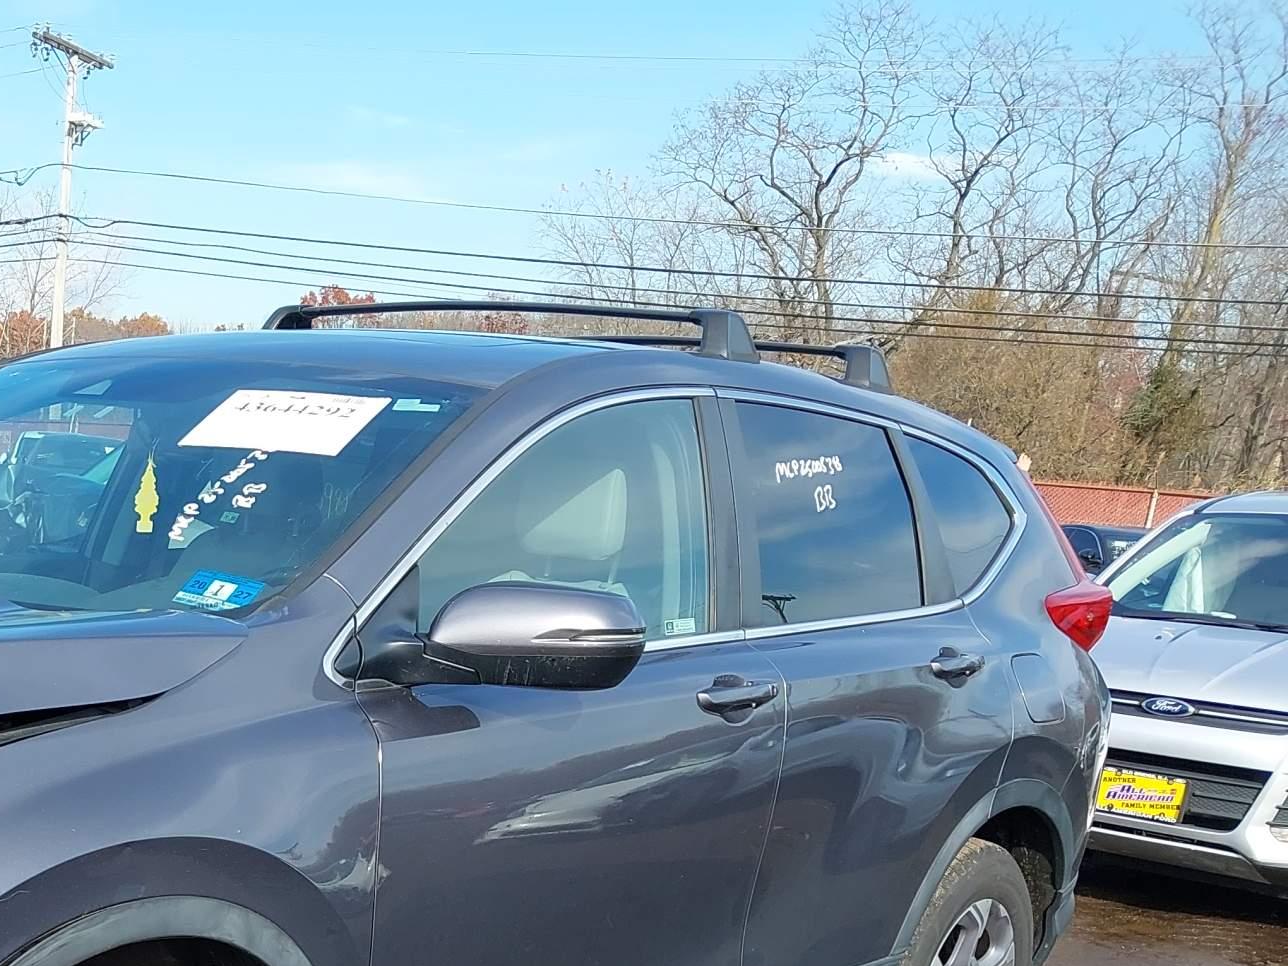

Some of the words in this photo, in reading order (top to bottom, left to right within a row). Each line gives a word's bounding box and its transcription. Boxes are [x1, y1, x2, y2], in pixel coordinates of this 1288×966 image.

[212, 584, 225, 597] 1
[234, 590, 253, 600] 27
[1151, 699, 1183, 713] Ford
